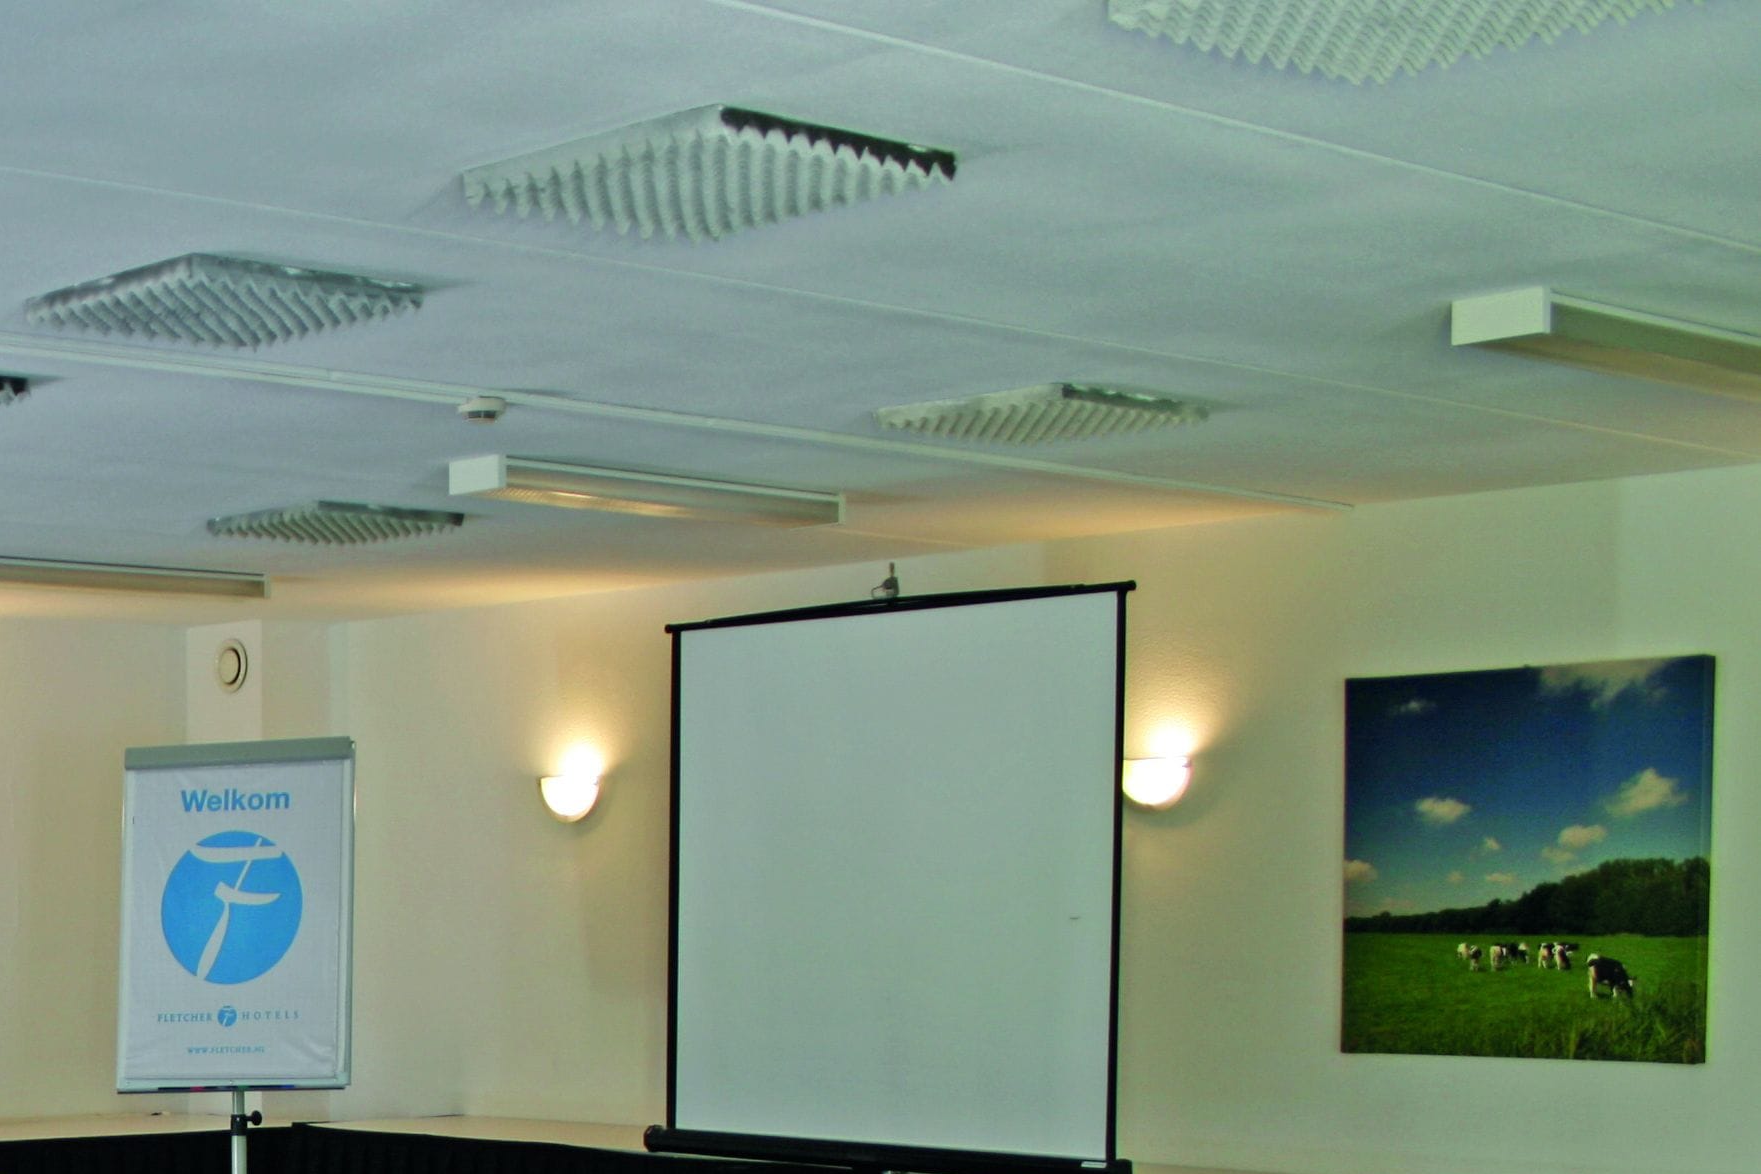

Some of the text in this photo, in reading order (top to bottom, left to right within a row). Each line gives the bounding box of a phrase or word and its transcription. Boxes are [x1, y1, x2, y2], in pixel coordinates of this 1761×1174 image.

[181, 788, 290, 812] Welkom
[157, 1010, 299, 1022] FLETCHER HOTELS
